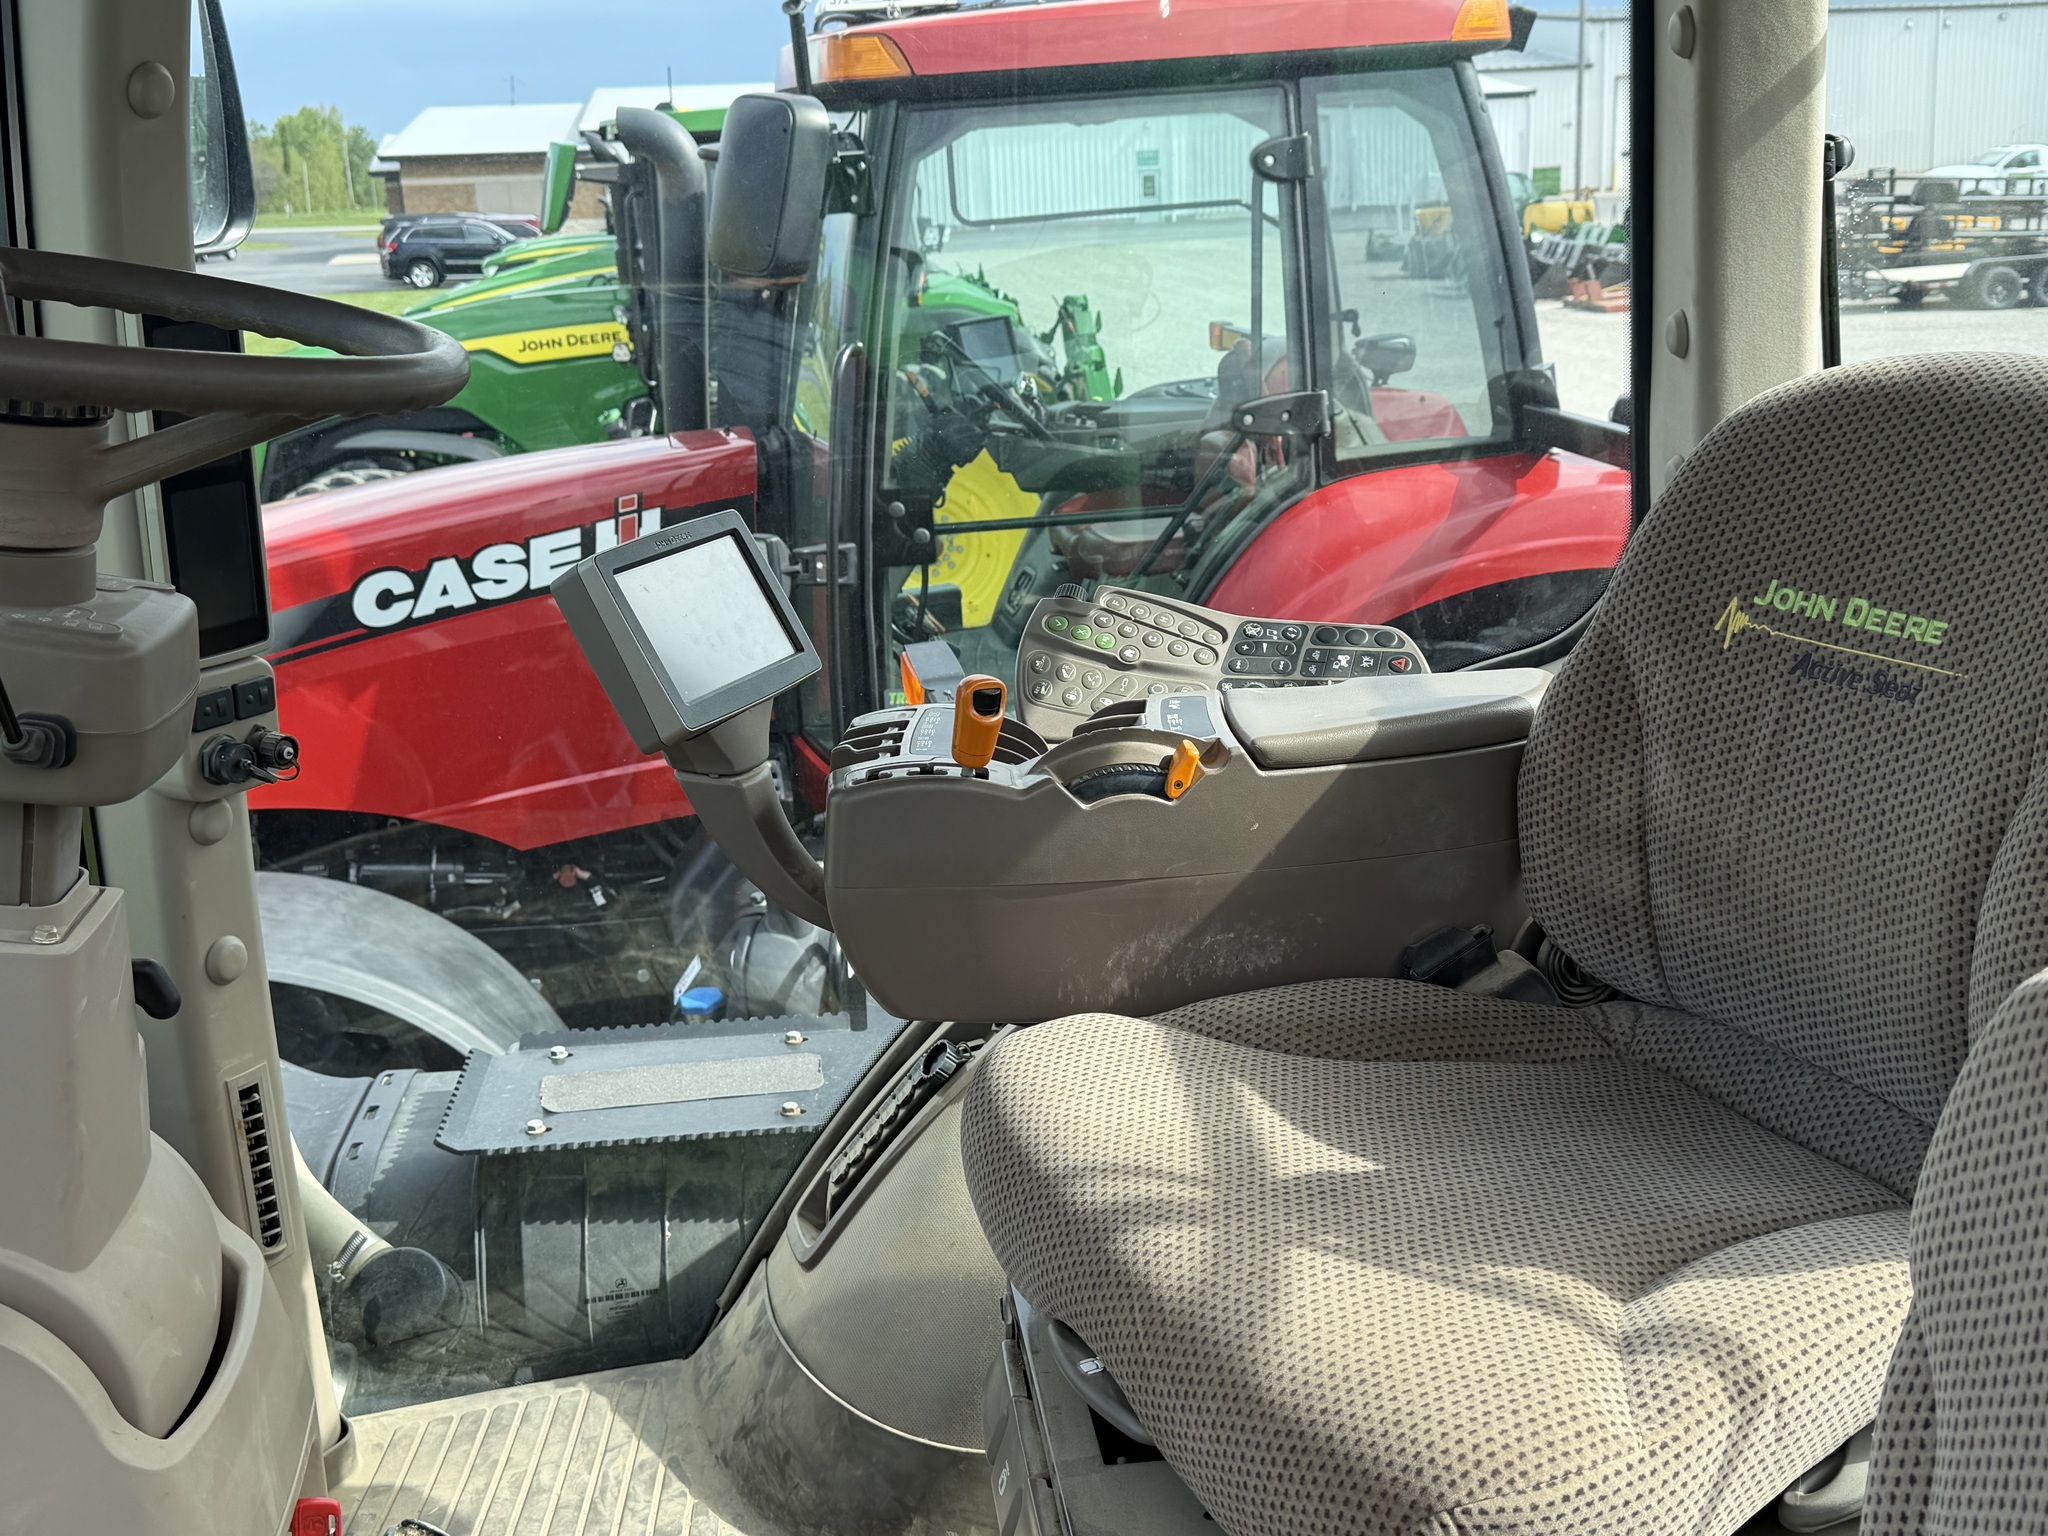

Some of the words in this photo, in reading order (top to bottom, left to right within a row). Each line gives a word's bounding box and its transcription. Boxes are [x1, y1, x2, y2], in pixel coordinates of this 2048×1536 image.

[518, 338, 562, 353] JOHN
[566, 331, 622, 347] DEERE
[352, 526, 581, 628] CASE
[1753, 579, 1838, 622] JOHN
[1842, 597, 1949, 645] DEERE
[1788, 652, 1864, 690] Active
[1867, 669, 1925, 704] Seat
